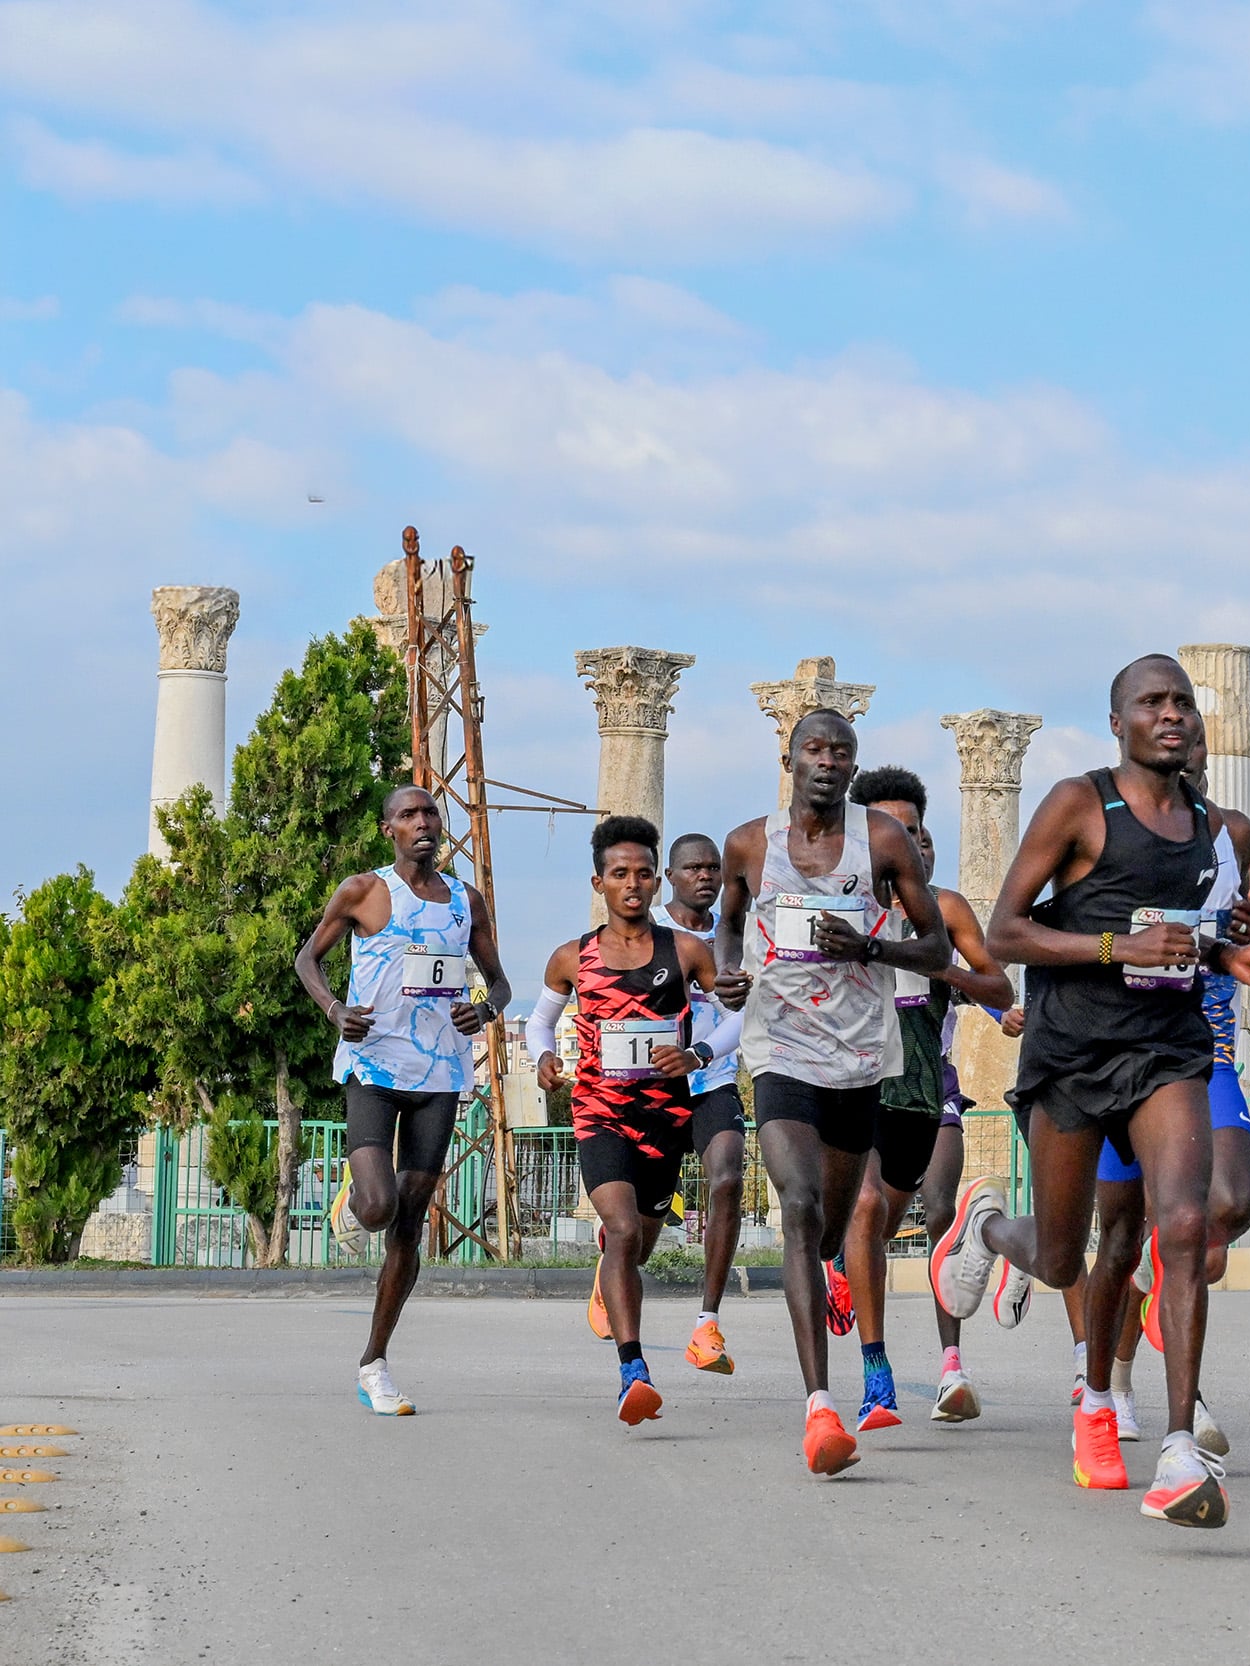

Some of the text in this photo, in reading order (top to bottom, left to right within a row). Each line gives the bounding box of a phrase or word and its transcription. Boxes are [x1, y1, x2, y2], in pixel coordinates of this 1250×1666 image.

[780, 895, 803, 907] 42K
[1138, 910, 1164, 923] 42K
[408, 944, 428, 953] 42K
[432, 959, 444, 985] 6
[604, 1022, 625, 1031] 42K
[628, 1037, 653, 1064] 11
